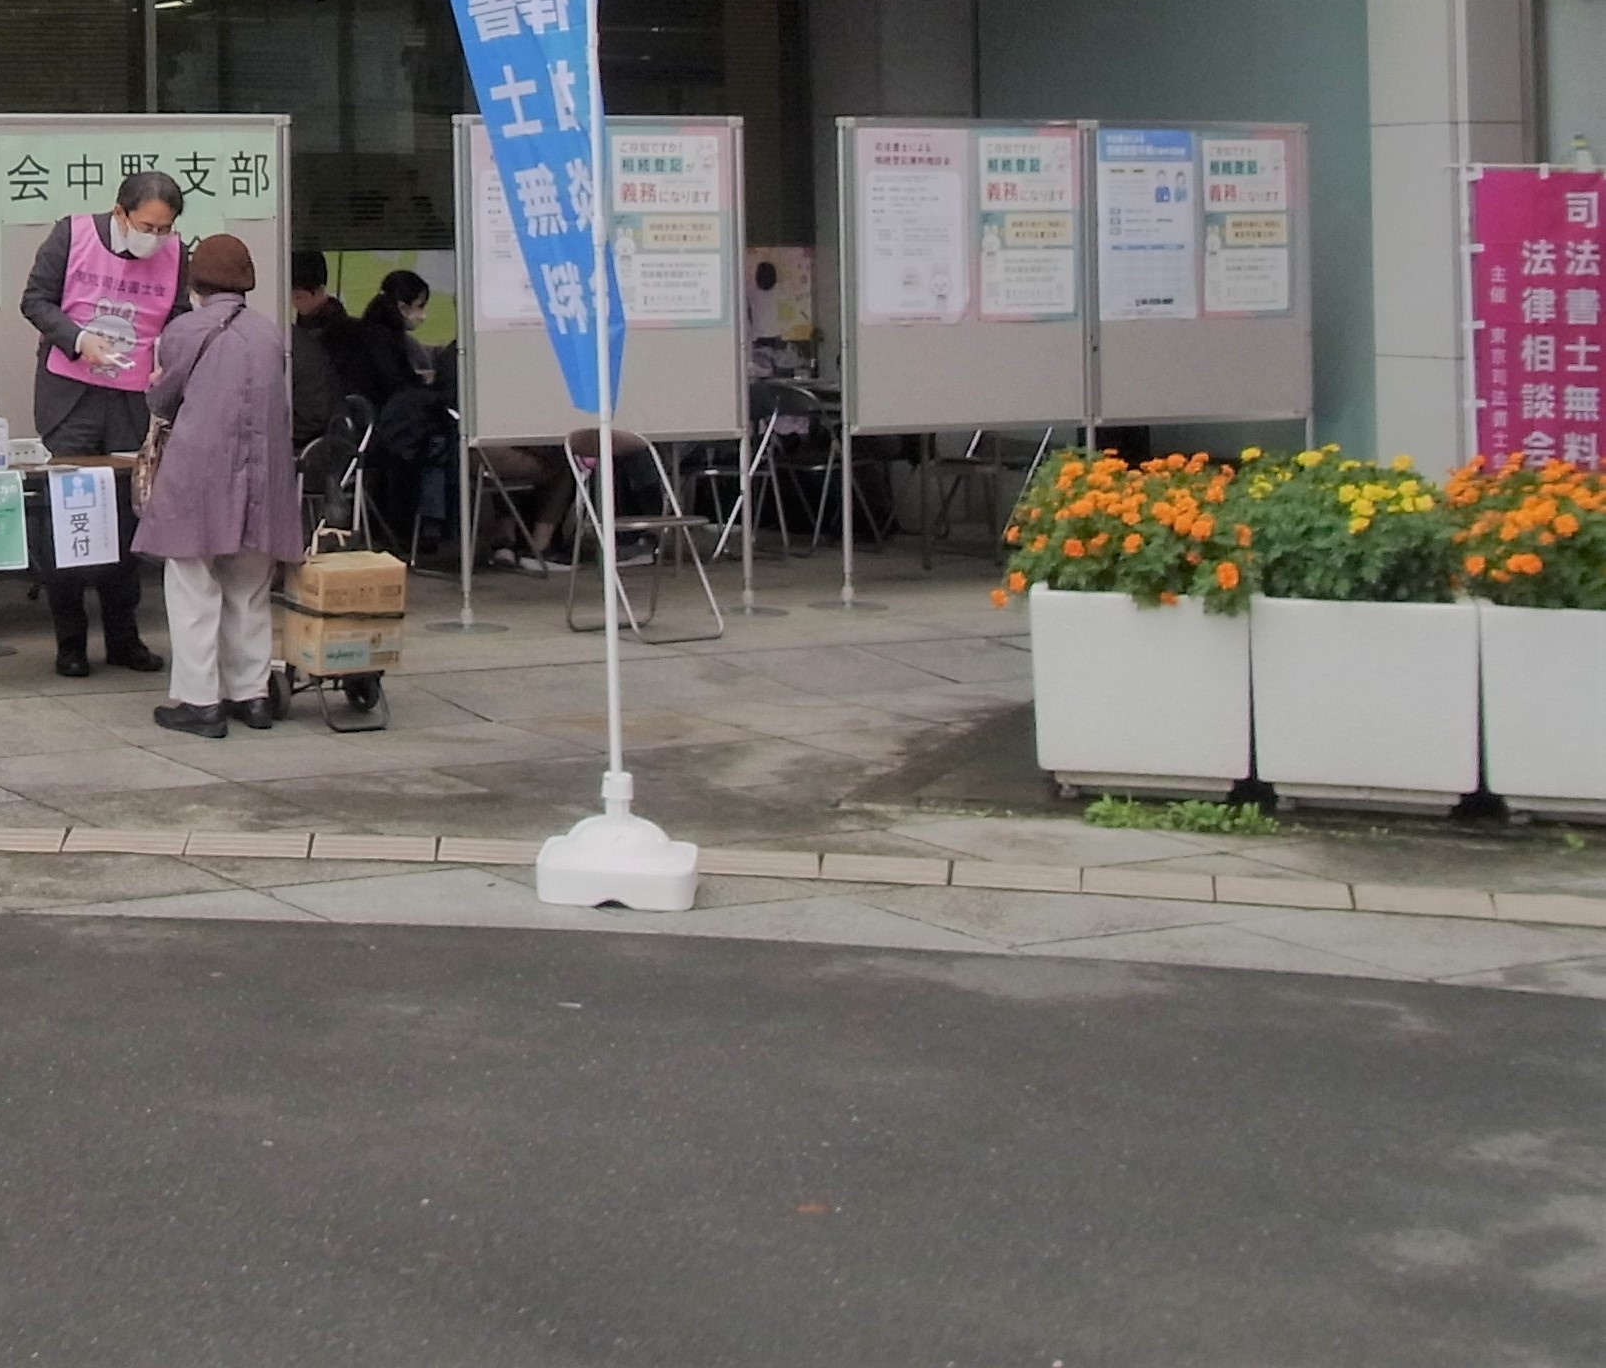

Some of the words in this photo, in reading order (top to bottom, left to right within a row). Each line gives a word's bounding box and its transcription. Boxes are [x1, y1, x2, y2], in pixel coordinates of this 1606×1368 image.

[620, 182, 712, 204] 義務になります
[986, 182, 1065, 202] 義務になります
[1521, 239, 1557, 466] 法律相談会
[1564, 191, 1601, 470] 司法書士無料
[70, 512, 91, 558] 受付
